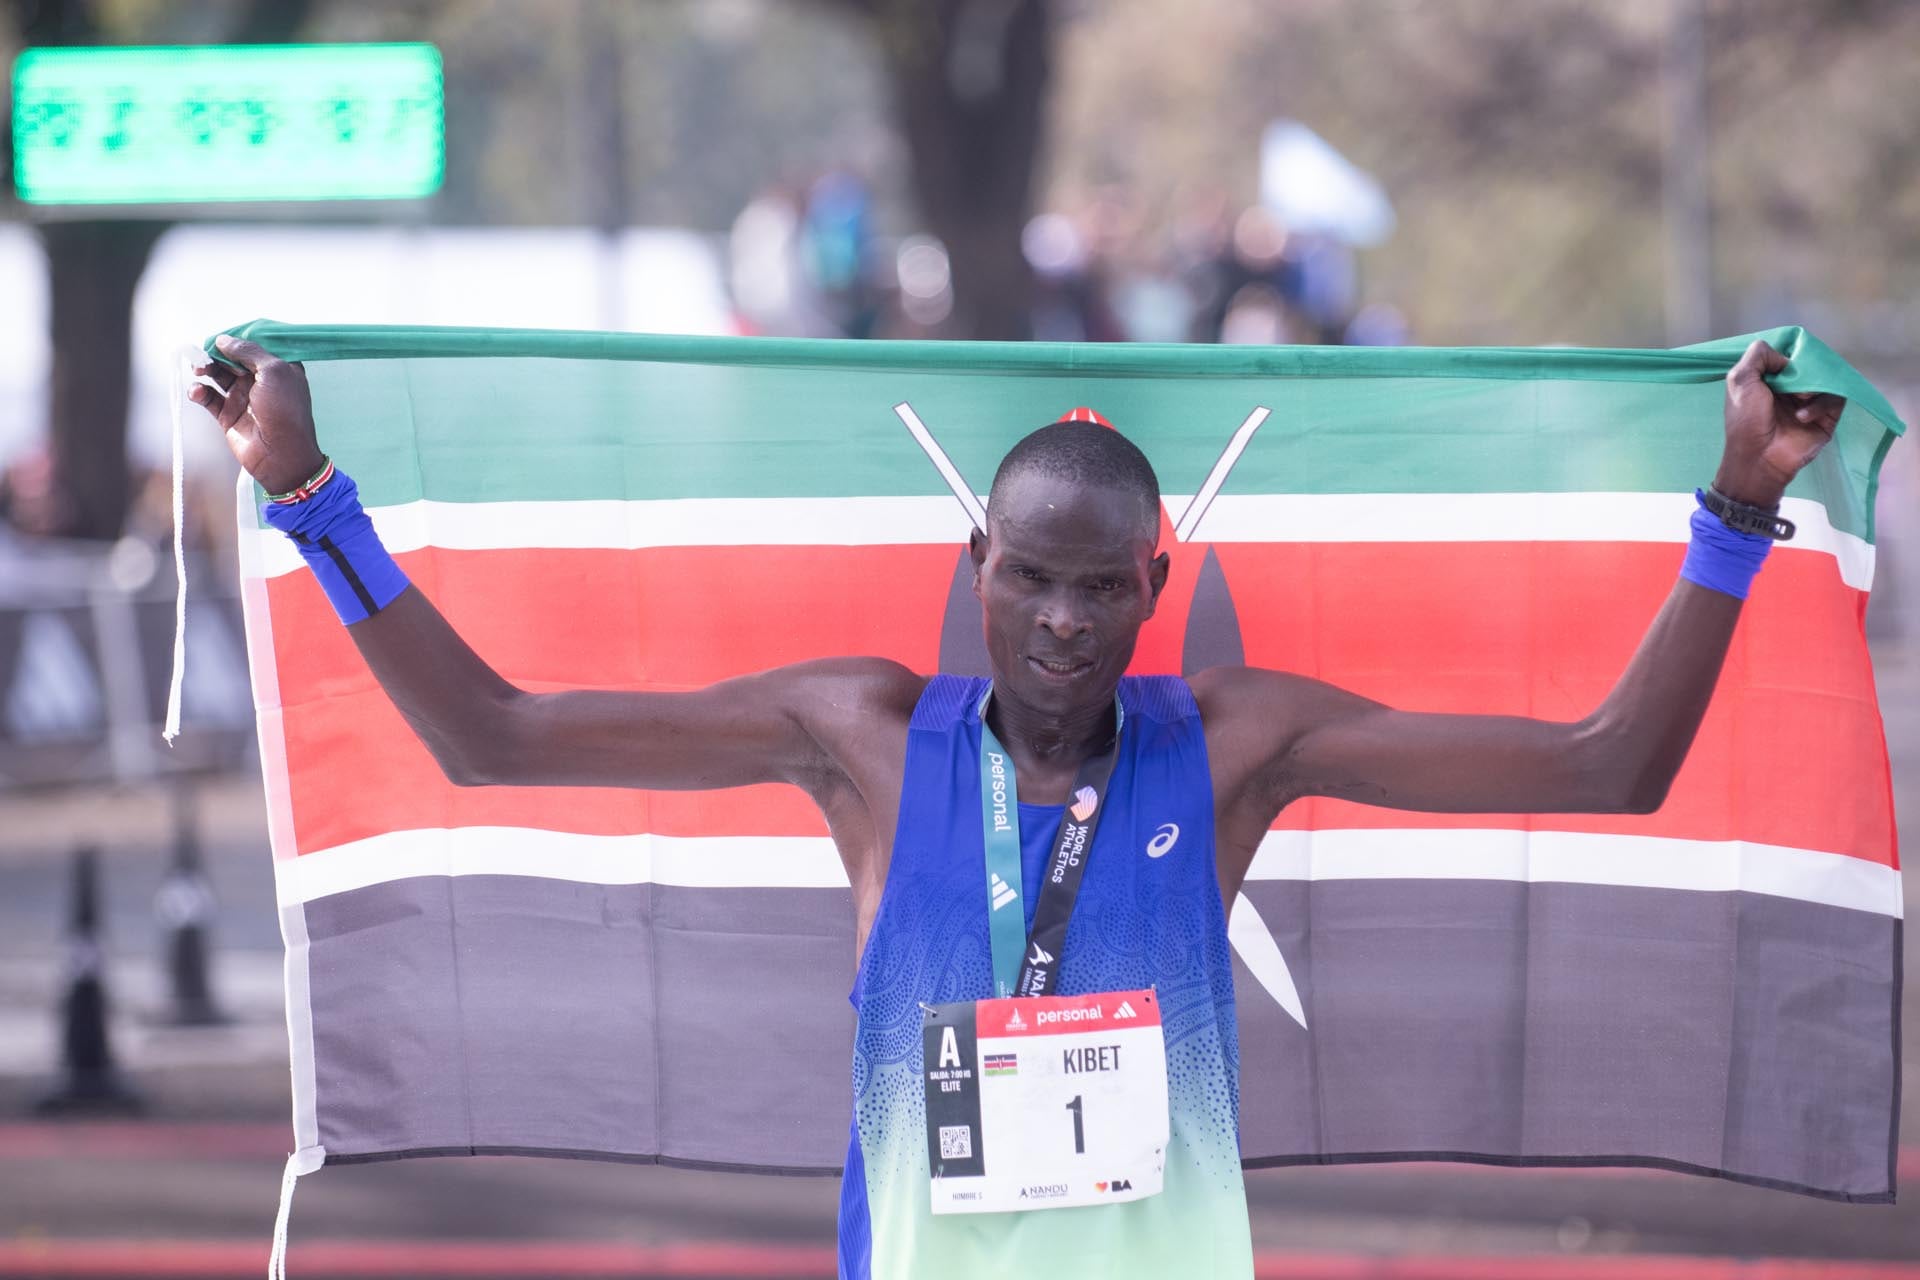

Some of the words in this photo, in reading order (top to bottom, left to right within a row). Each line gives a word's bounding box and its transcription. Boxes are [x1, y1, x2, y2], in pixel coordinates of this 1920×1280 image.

[988, 752, 1012, 832] personal
[1052, 822, 1077, 884] ATHLETICS
[1069, 826, 1089, 867] WORLD
[1037, 1005, 1103, 1026] personal
[939, 1026, 961, 1068] A
[1063, 1045, 1121, 1074] KIBET
[941, 1080, 961, 1092] ELITE
[1065, 1095, 1085, 1154] 1
